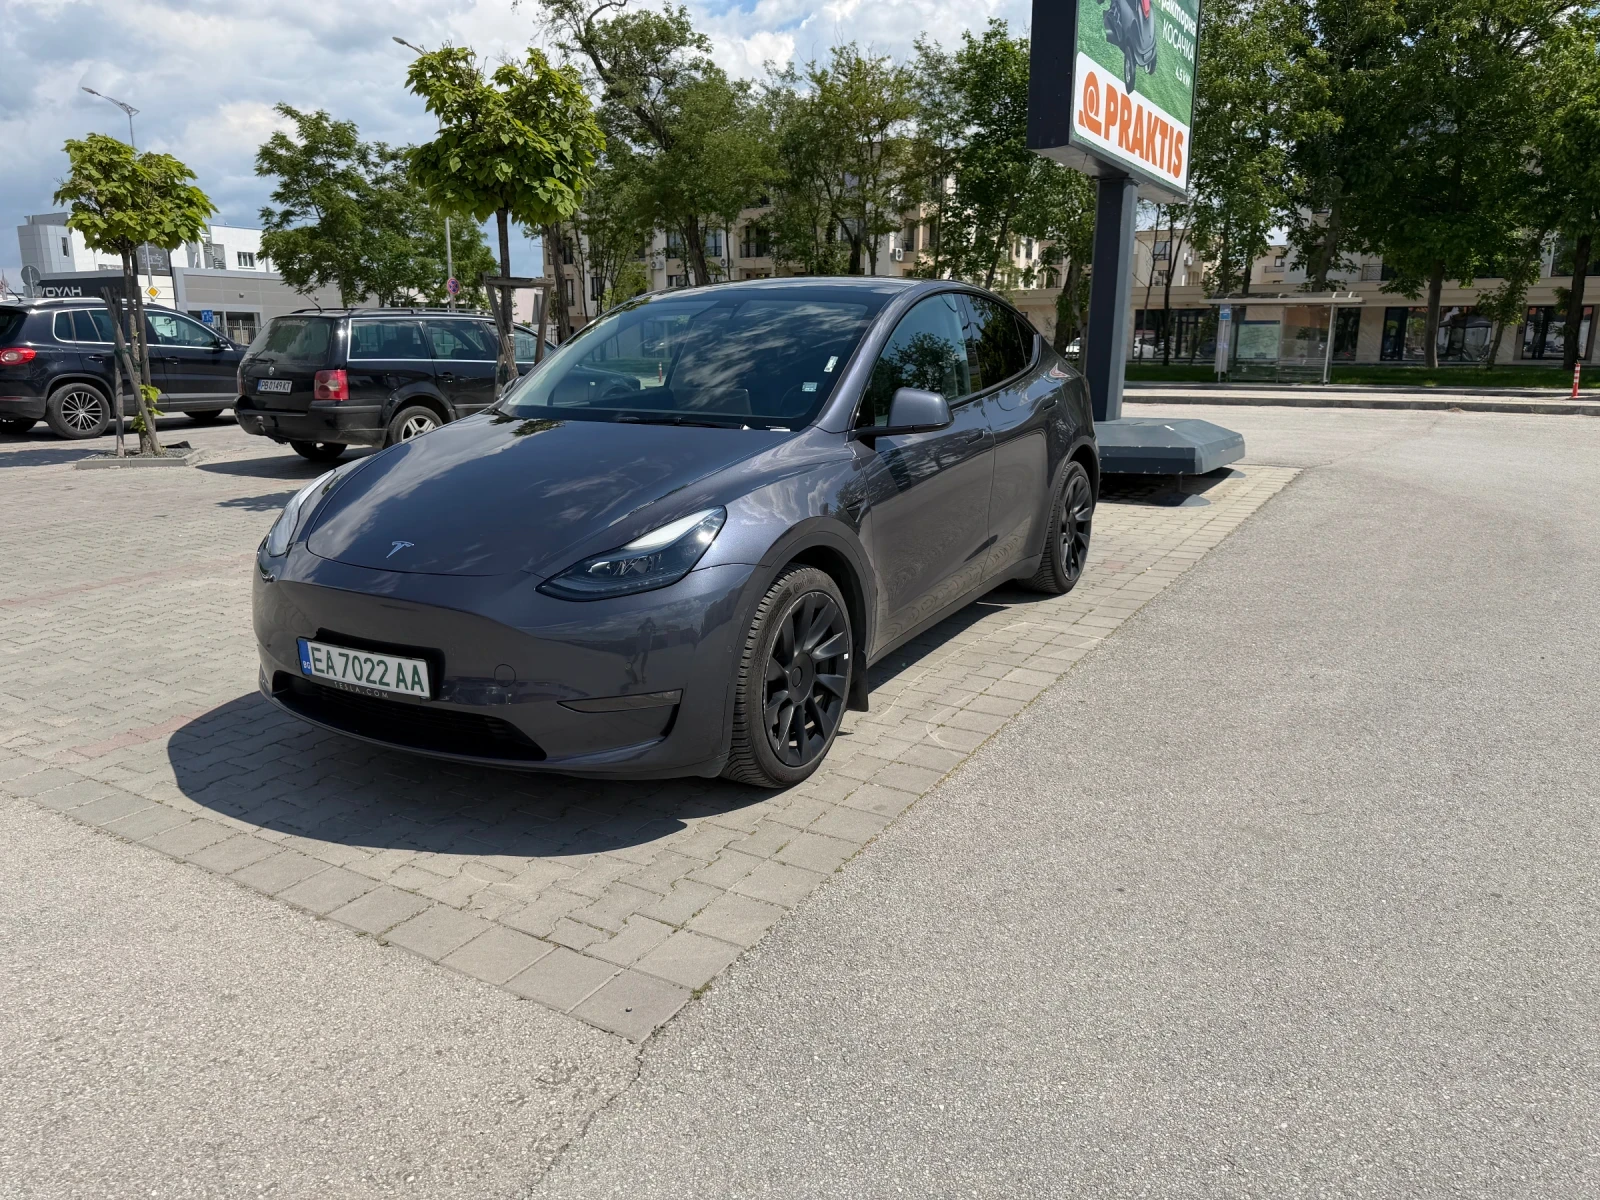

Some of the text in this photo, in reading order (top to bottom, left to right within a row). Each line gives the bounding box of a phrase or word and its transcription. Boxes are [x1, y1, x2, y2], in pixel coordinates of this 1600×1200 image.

[1158, 0, 1197, 37] ракторна
[1163, 18, 1194, 64] КОСАЧКА
[1103, 83, 1184, 179] PRAKTIS
[334, 681, 389, 698] TESLA.COM
[395, 662, 425, 692] AA
